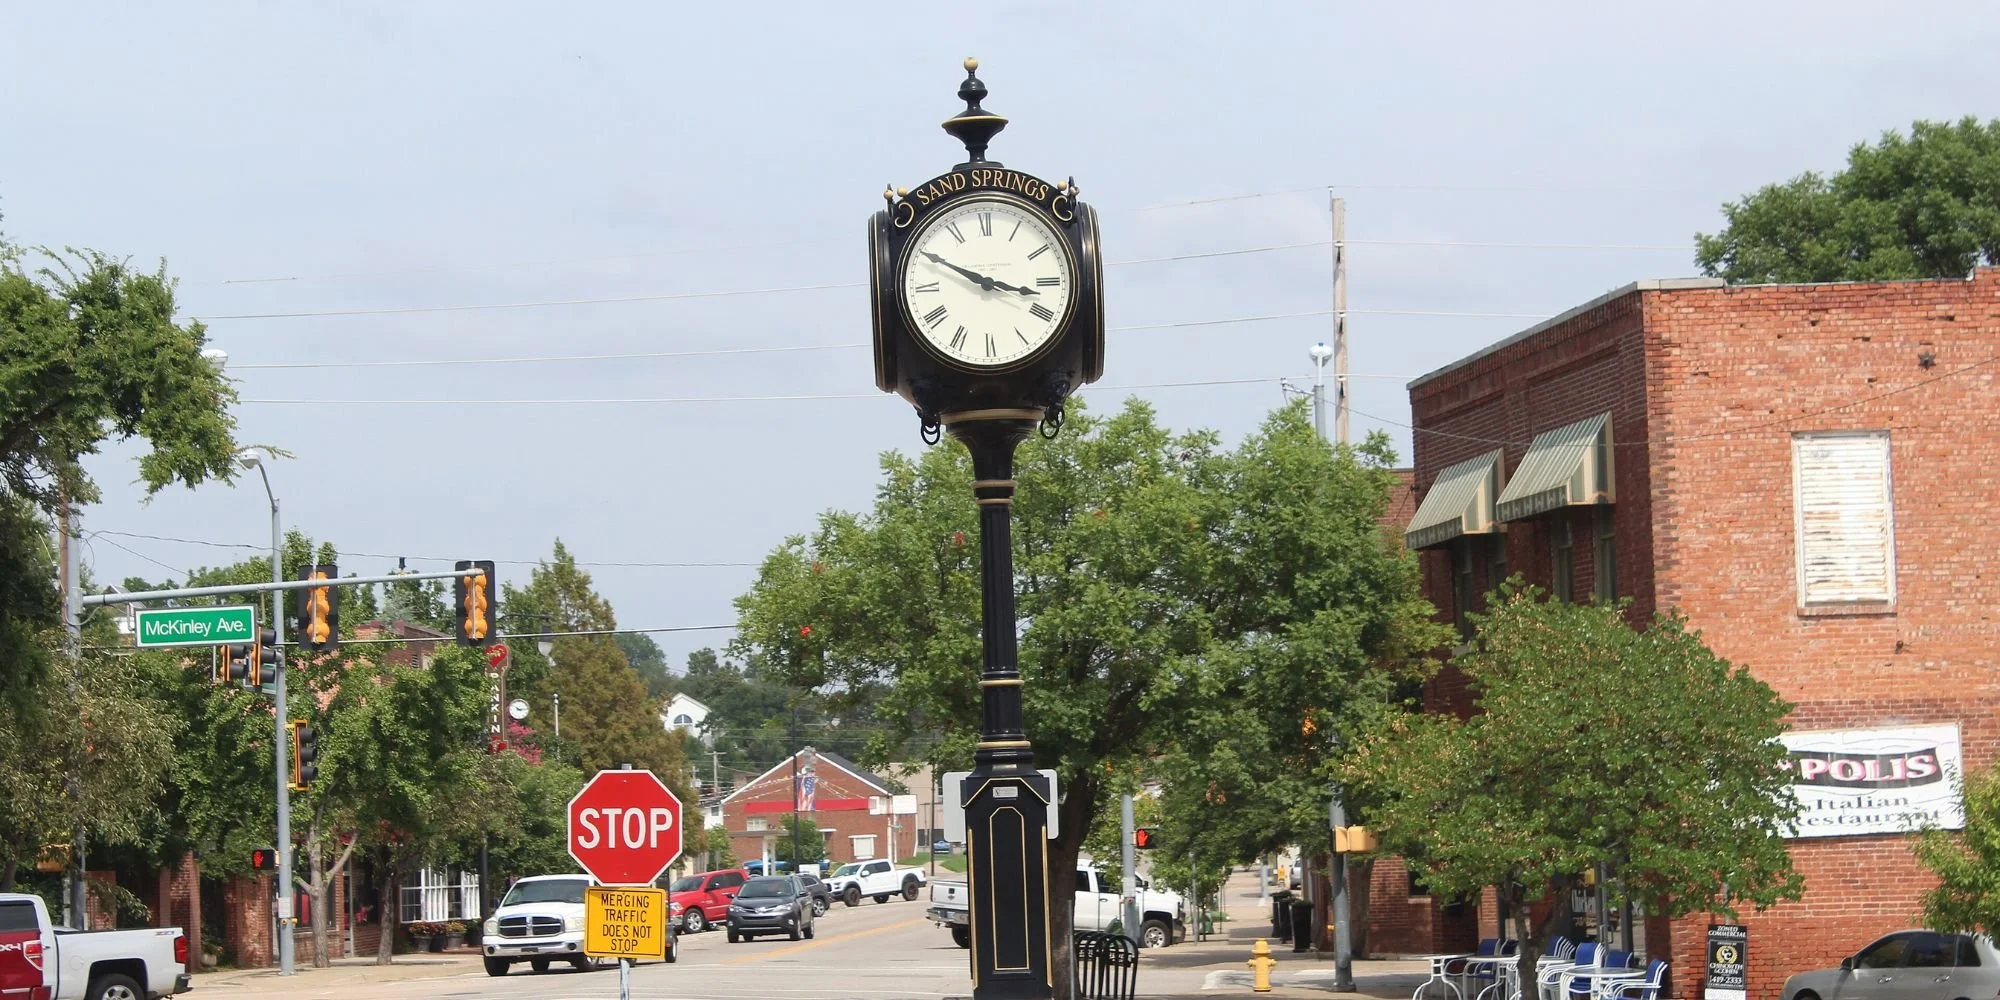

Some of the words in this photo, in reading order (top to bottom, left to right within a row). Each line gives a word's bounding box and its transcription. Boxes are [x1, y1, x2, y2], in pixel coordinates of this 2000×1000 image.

[916, 173, 966, 205] SAND
[971, 169, 1049, 200] SPRINGS
[977, 213, 992, 236] XII
[1036, 276, 1060, 287] III
[145, 619, 212, 637] McKinley
[216, 618, 247, 633] Ave.
[1776, 754, 1938, 781] POLIS
[1816, 796, 1909, 810] Italian
[577, 807, 673, 849] STOP
[601, 893, 650, 909] MERGING
[604, 909, 647, 923] TRAFFIC
[602, 924, 629, 938] DOES
[632, 925, 652, 938] NOT
[610, 938, 638, 951] STOP
